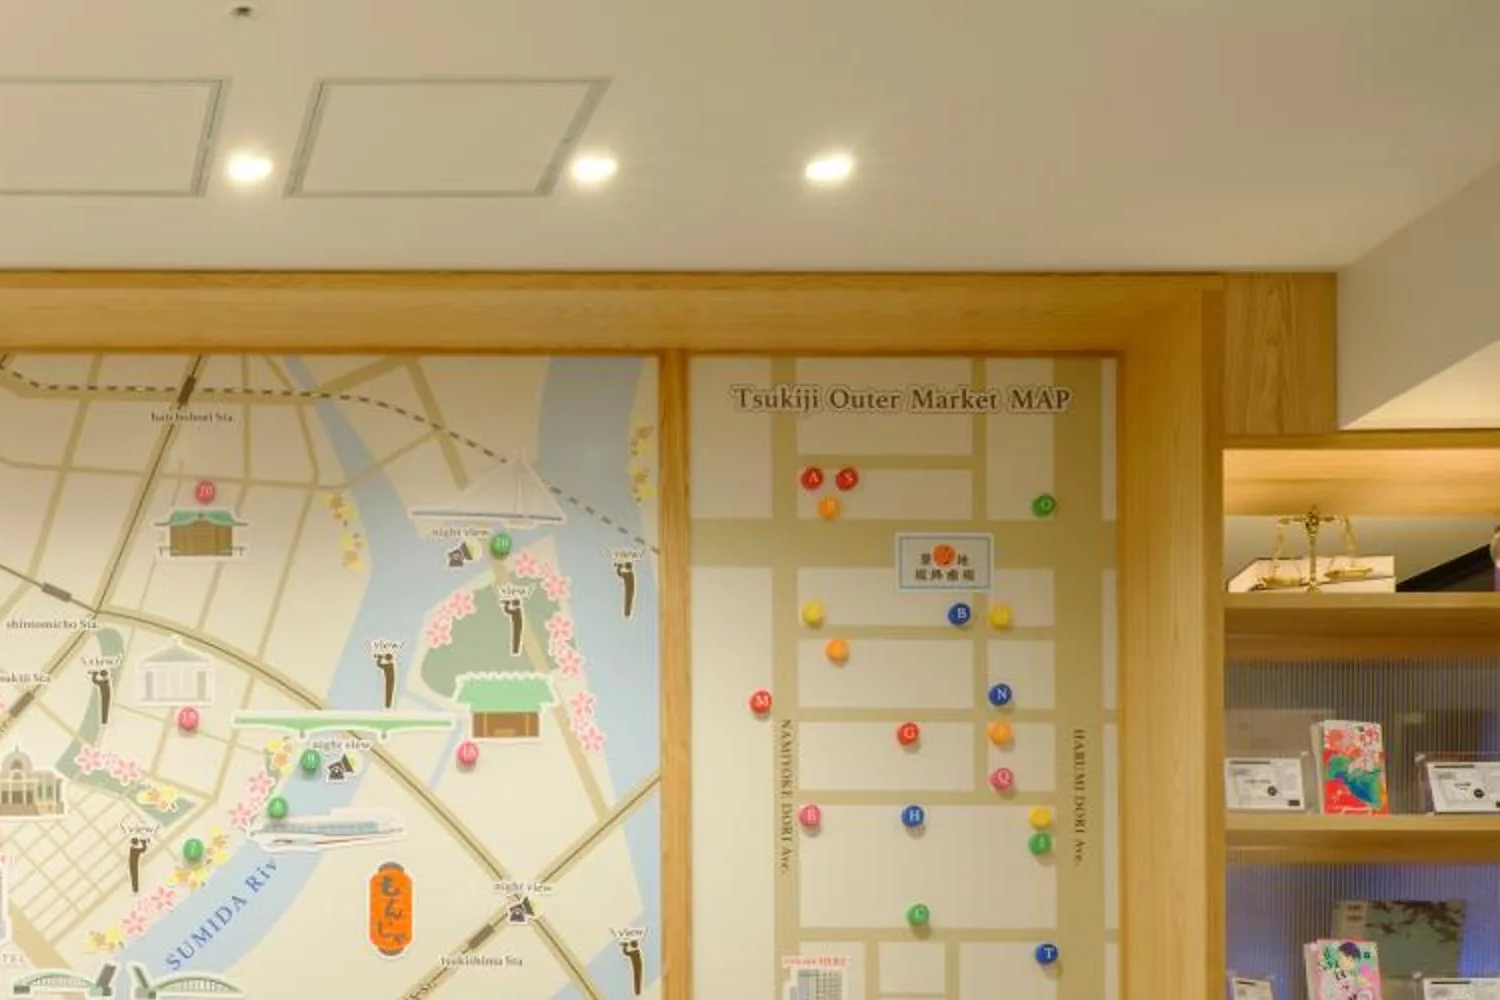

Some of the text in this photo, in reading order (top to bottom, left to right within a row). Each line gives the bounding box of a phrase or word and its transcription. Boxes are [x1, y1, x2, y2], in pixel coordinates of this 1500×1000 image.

[734, 388, 1071, 412] Tsukiji Outer Market MAP
[165, 893, 248, 972] SUMIDA
